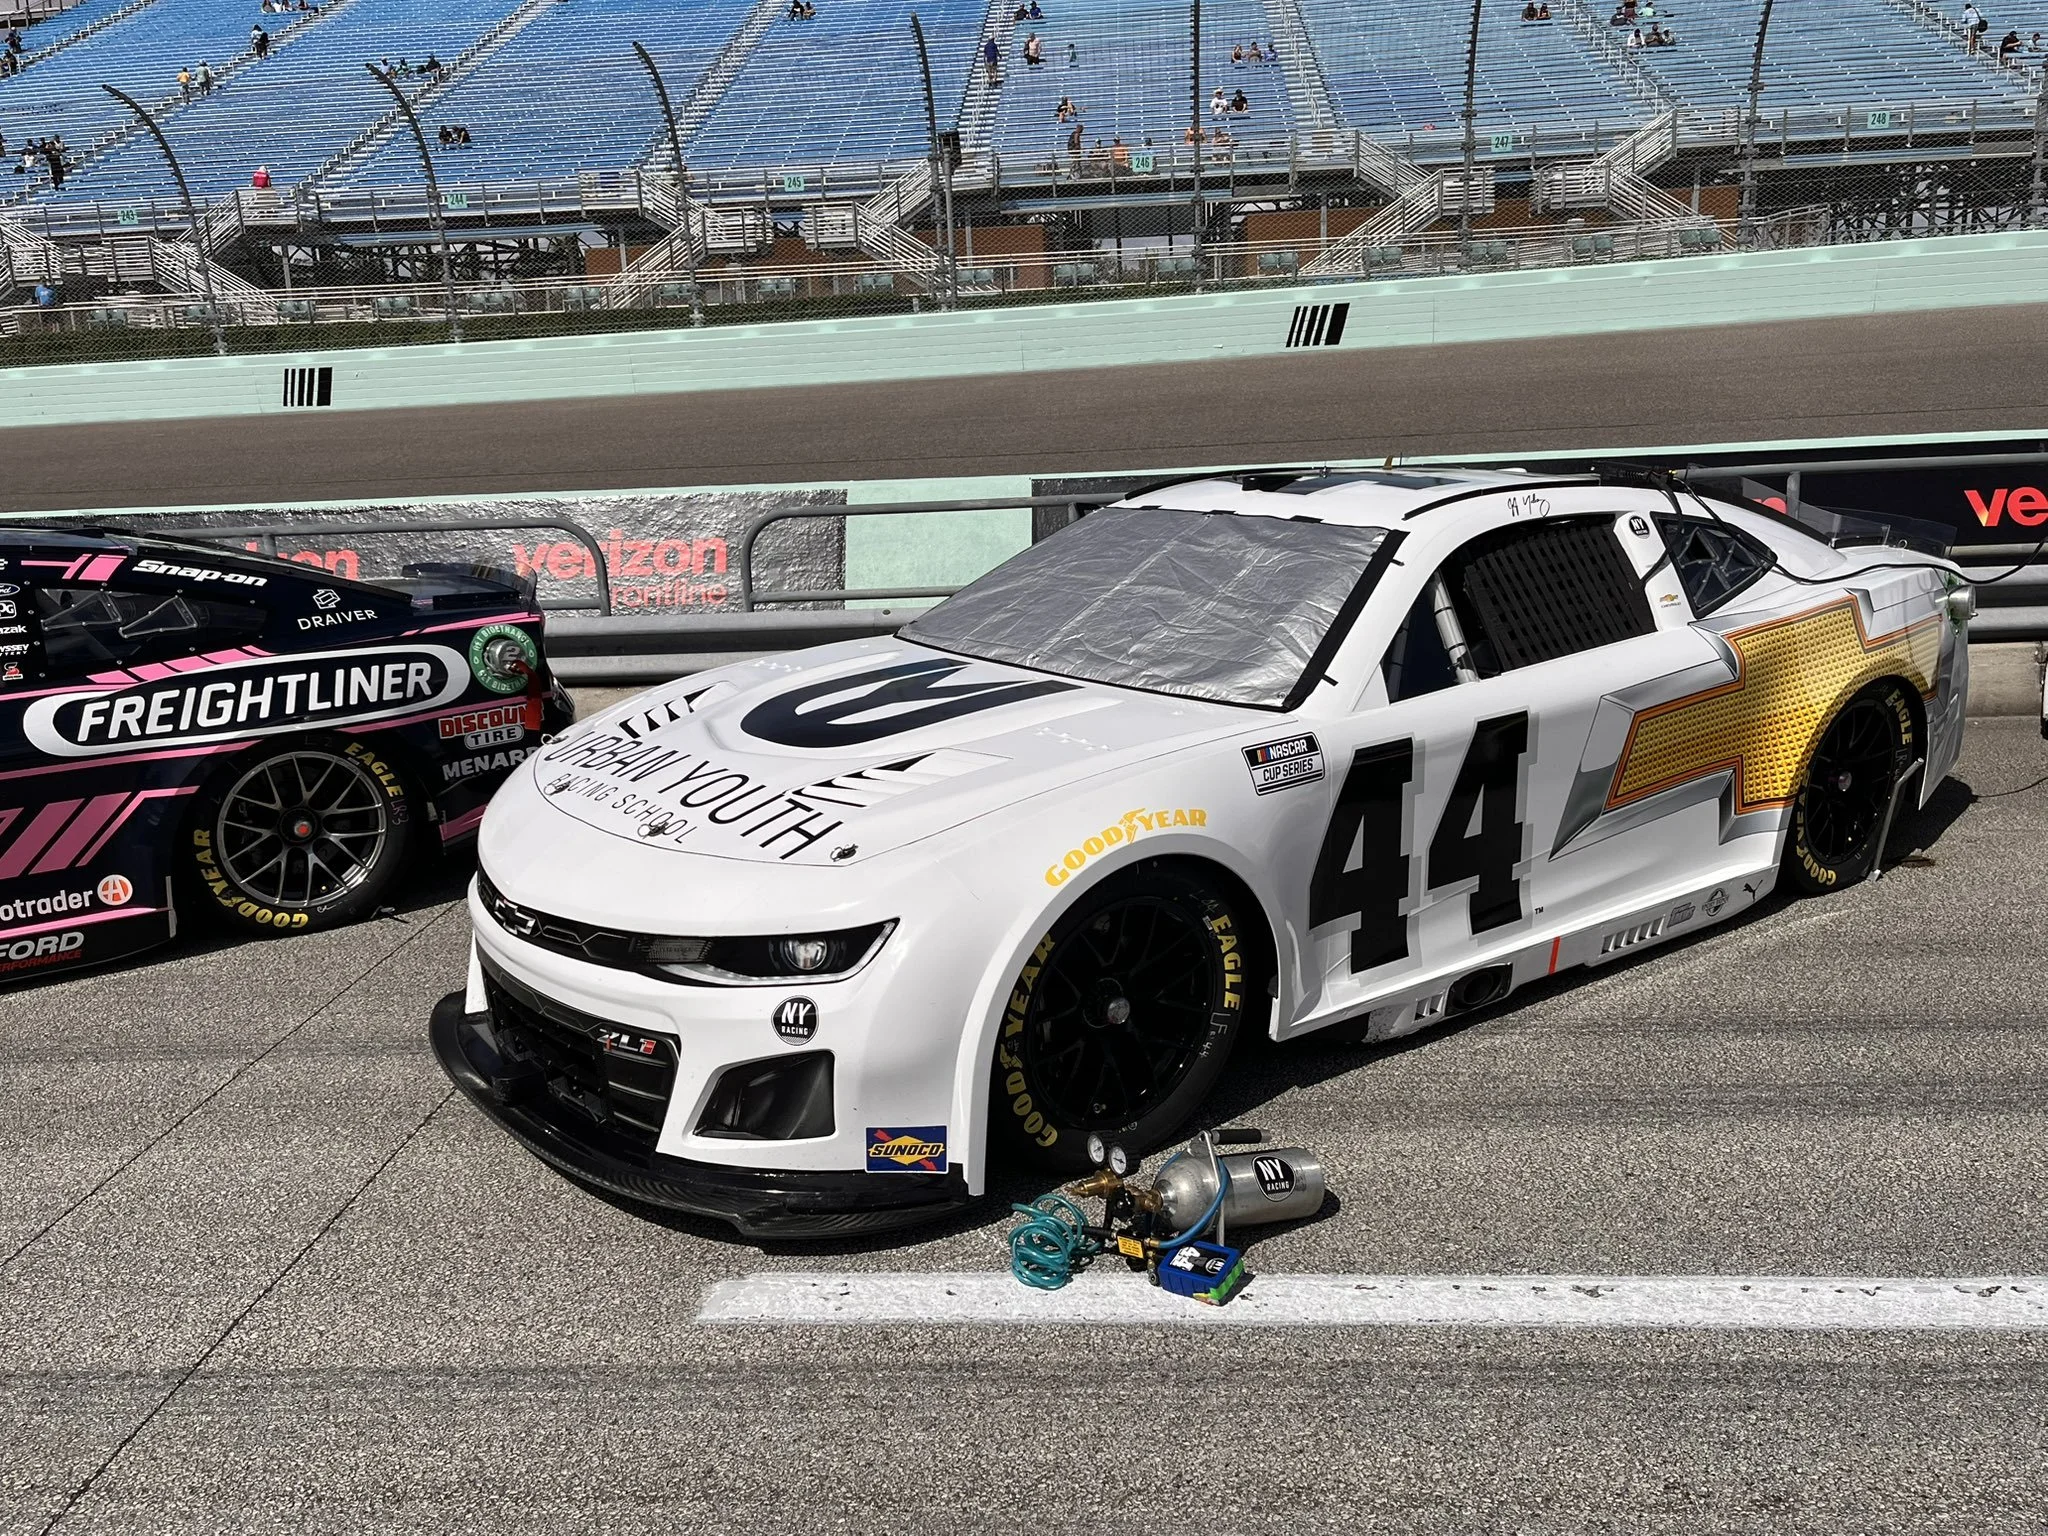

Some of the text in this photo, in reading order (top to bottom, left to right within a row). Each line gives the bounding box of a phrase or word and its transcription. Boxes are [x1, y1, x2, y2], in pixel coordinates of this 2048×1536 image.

[1871, 112, 1886, 125] 248
[1495, 136, 1509, 148] 247
[1135, 157, 1150, 168] 246
[787, 176, 802, 188] 245
[450, 193, 464, 205] 244
[120, 209, 135, 221] 243
[1630, 518, 1645, 530] NY
[132, 559, 268, 587] Snap-on
[609, 577, 728, 608] rontline
[297, 609, 378, 630] DRAIVER
[492, 679, 527, 691] BIOETHA
[77, 663, 432, 742] FREIGHTLINER
[1884, 688, 1913, 745] EAGLE
[471, 727, 517, 746] TIRE
[1268, 739, 1308, 760] NASCAR
[344, 742, 404, 798] EAGLE
[1263, 757, 1314, 782] CUP SERIES
[544, 730, 844, 861] URBAN YOUTH
[612, 793, 698, 844] SCHOOL
[1045, 808, 1208, 887] GOODYEAR
[1309, 709, 1529, 976] 44
[193, 829, 309, 928] GOODYEAR
[1535, 906, 1545, 915] TM
[1210, 914, 1242, 1011] EAGLE
[780, 1002, 812, 1026] NY
[780, 1025, 809, 1036] RACING
[1000, 931, 1058, 1147] GOODYEAR
[871, 1144, 943, 1156] SUNOCO
[1256, 1158, 1285, 1181] NY
[1266, 1180, 1290, 1192] RACING
